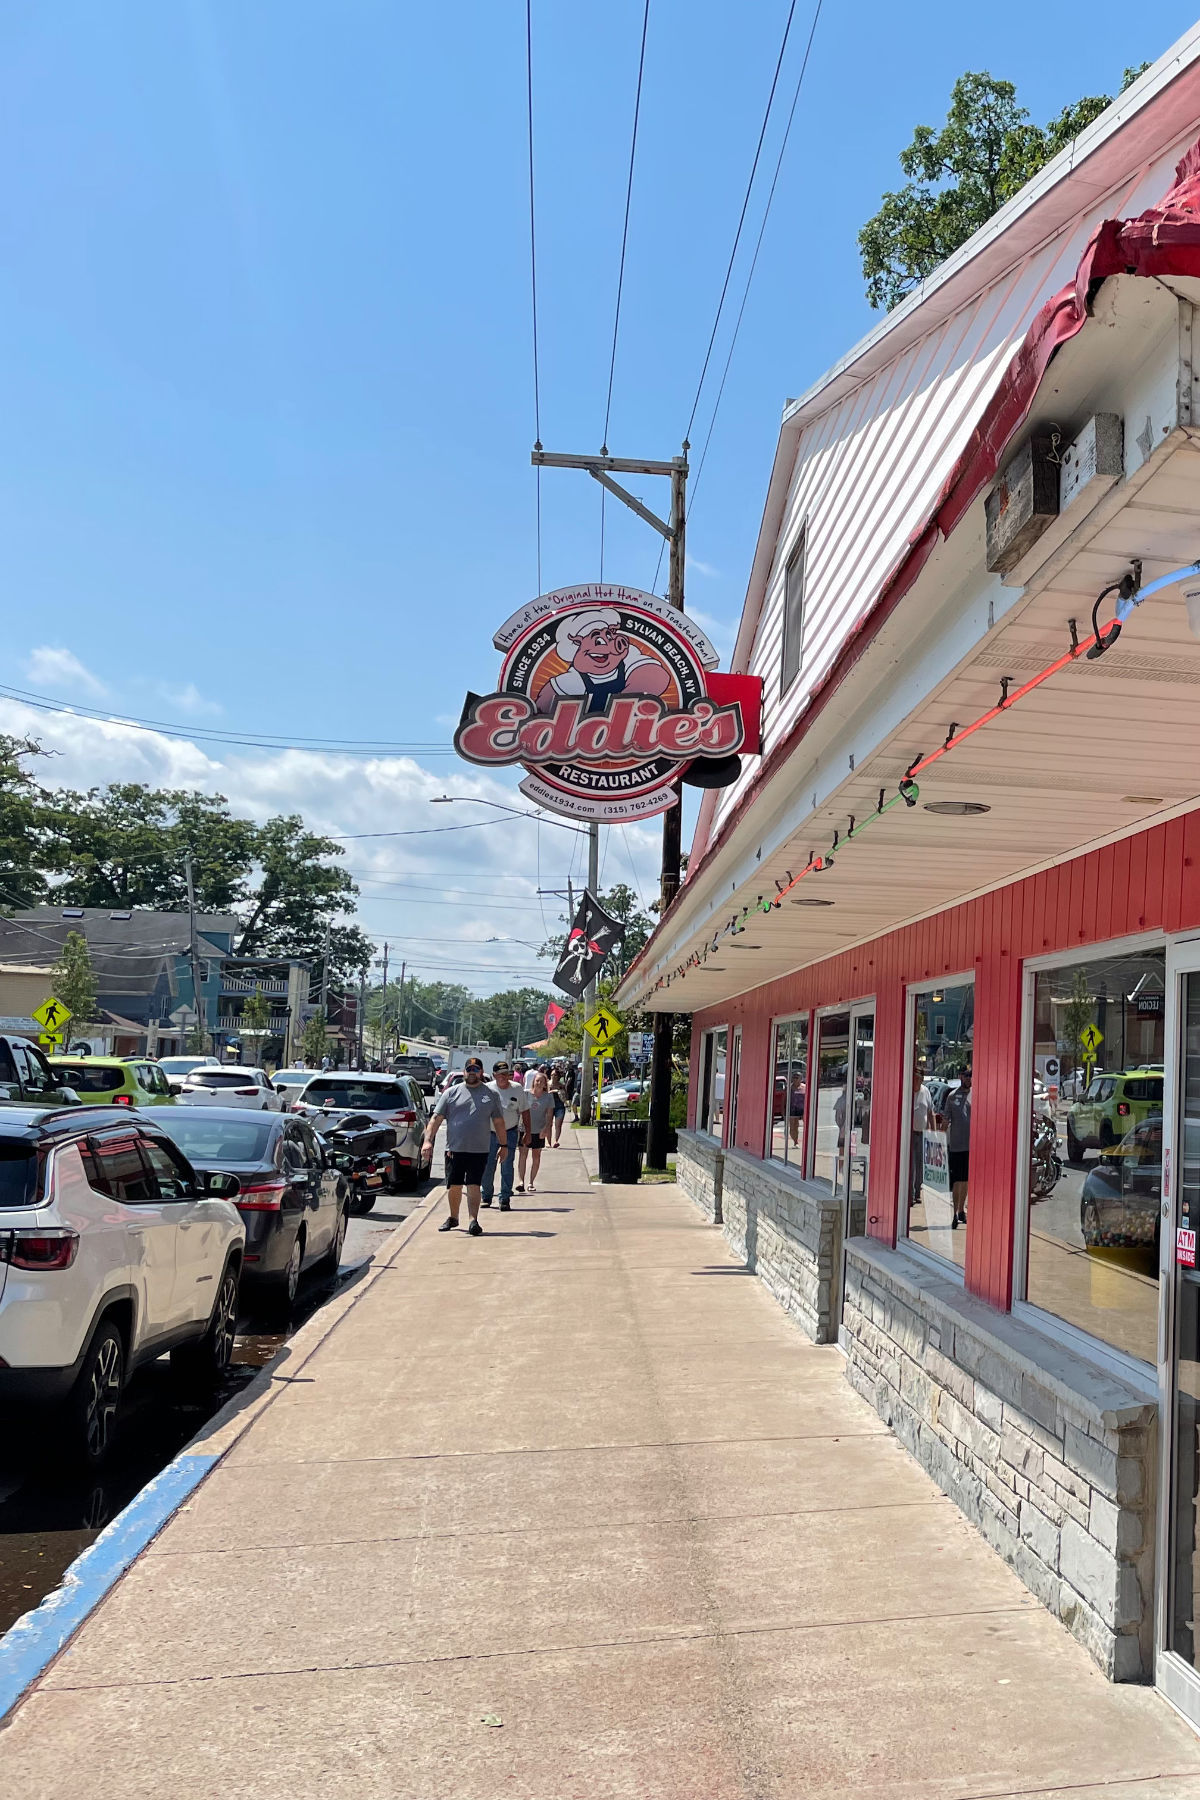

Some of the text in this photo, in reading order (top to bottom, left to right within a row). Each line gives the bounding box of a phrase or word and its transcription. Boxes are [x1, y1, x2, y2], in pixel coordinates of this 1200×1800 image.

[498, 622, 524, 644] Home
[523, 611, 532, 624] of
[533, 603, 550, 618] the
[548, 586, 592, 605] "Original
[595, 586, 615, 599] Hot
[616, 588, 643, 602] Ham"
[643, 600, 654, 609] on
[664, 609, 697, 642] Toasted
[694, 637, 715, 663] Bun!
[513, 633, 551, 688] SINCE 1934
[625, 619, 698, 694] SYLVAN BEACH, NY
[457, 695, 741, 762] Eddie's
[558, 763, 660, 789] RESTAURANT
[529, 782, 595, 813] eddies1934.com
[603, 791, 669, 815] (315) 762-4269
[1177, 1231, 1195, 1249] ATM
[1177, 1248, 1195, 1263] INSIDE
